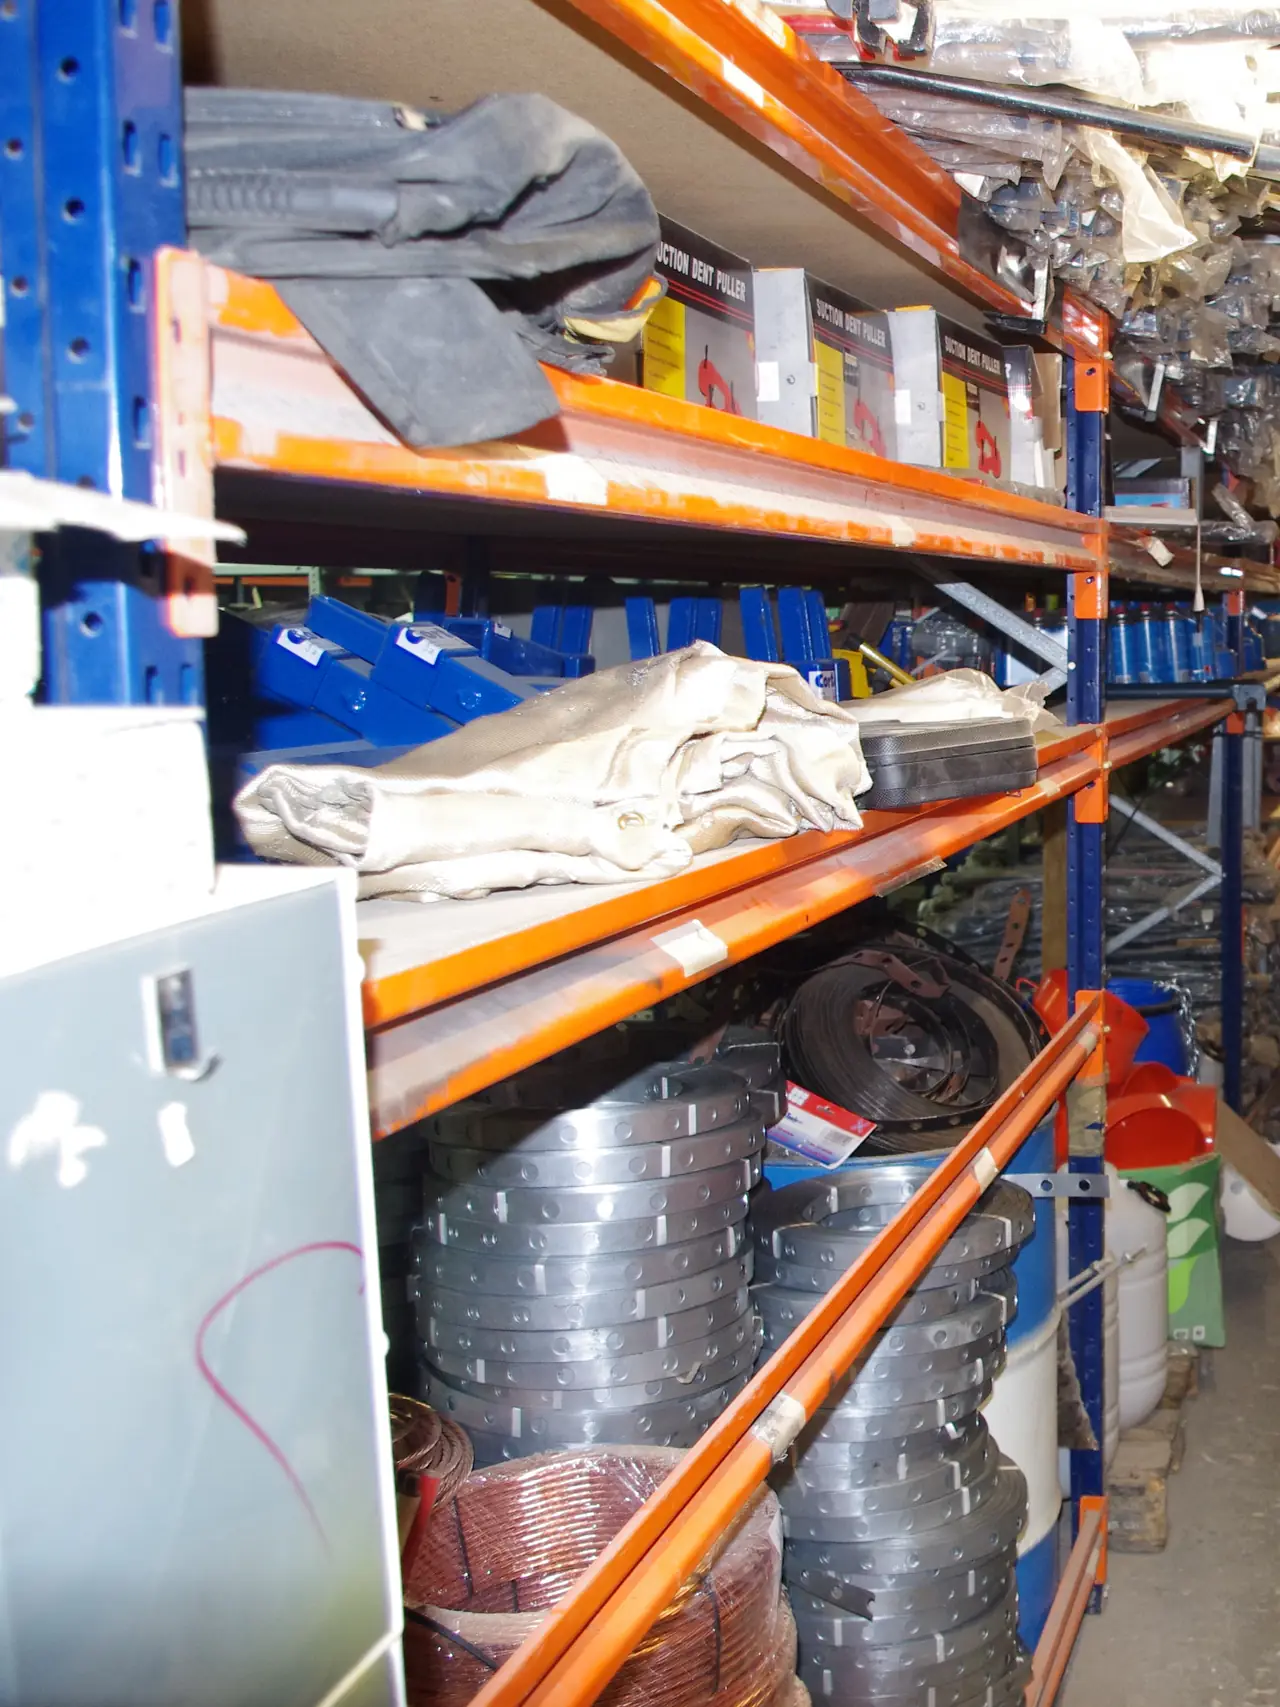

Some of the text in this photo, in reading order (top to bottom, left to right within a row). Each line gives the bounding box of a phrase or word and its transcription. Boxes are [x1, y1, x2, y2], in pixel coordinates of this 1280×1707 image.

[656, 241, 746, 302] UCTION DENT PULLER
[816, 298, 886, 348] SUCTION DENT PULLER
